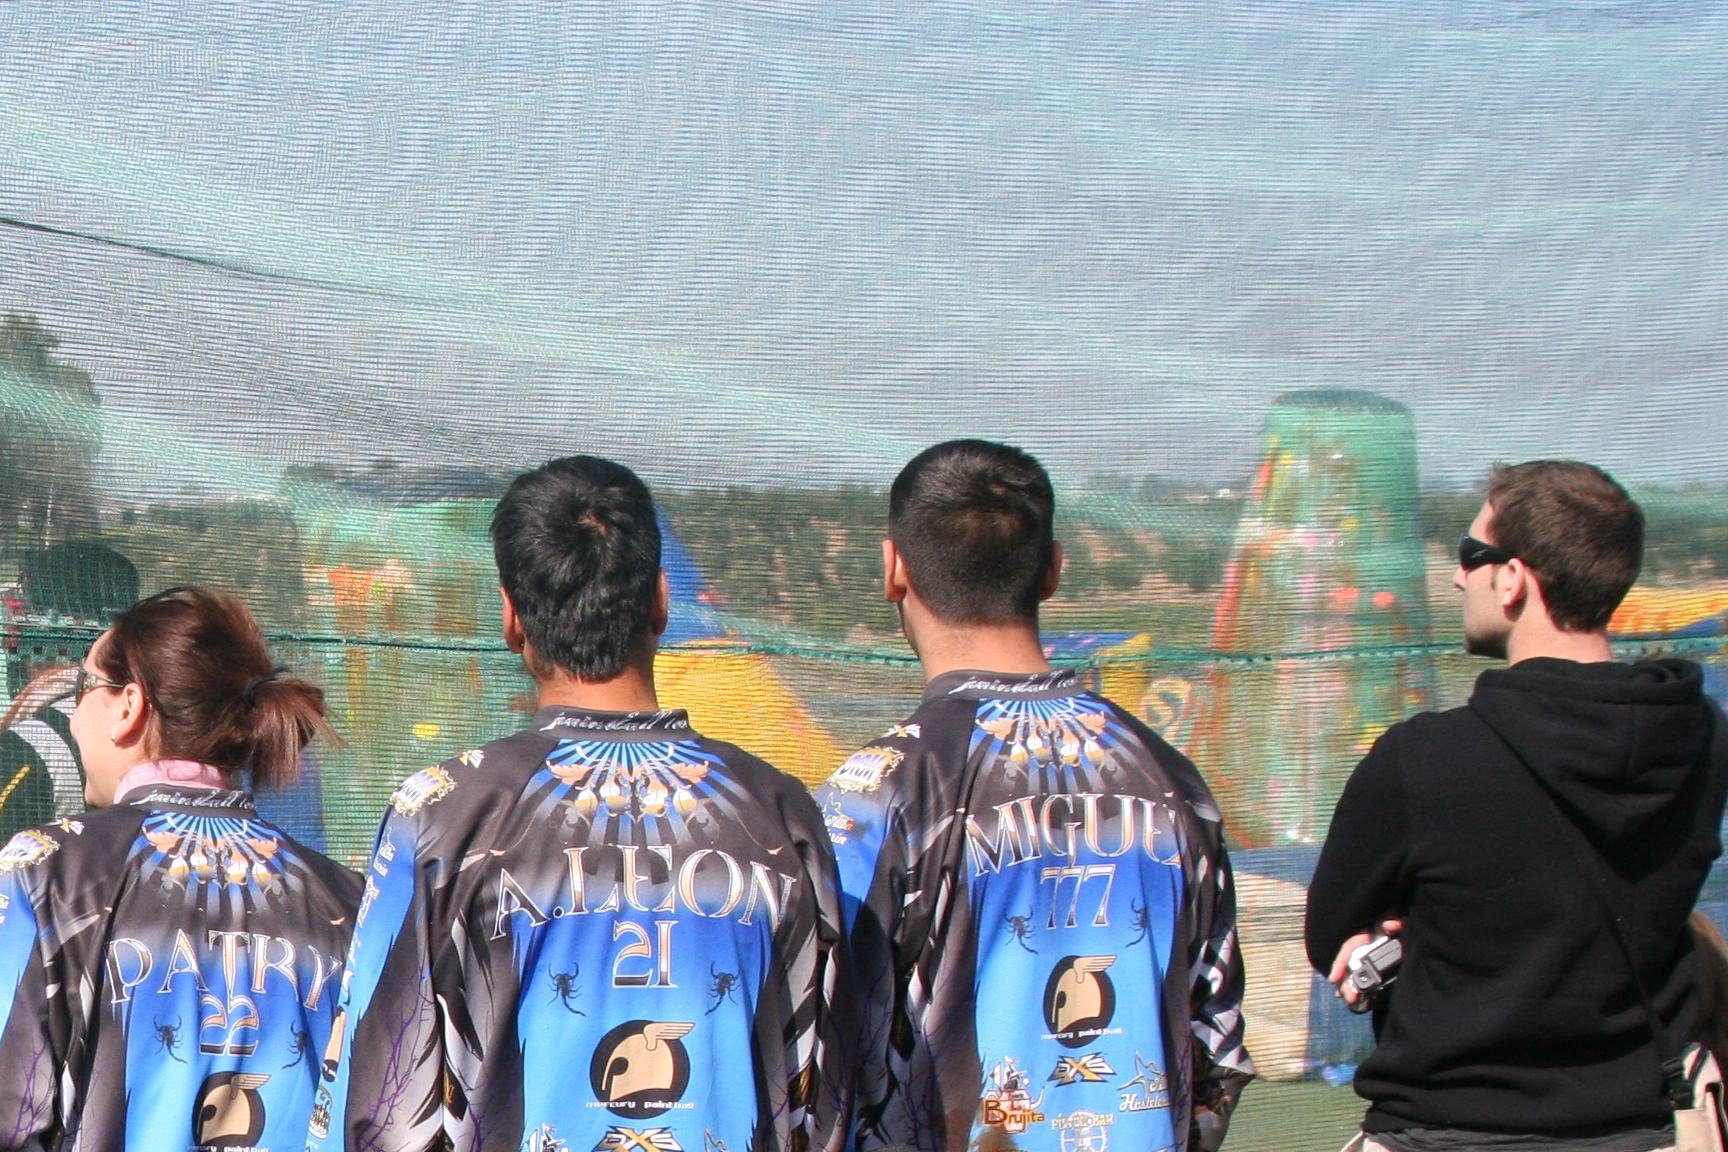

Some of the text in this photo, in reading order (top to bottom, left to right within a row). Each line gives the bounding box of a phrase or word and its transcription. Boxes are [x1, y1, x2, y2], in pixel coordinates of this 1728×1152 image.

[964, 792, 1182, 877] MIGUE
[490, 843, 798, 941] A.LEON
[1040, 863, 1117, 931] 777
[106, 928, 343, 1011] PATRY
[612, 919, 680, 989] 21
[199, 994, 261, 1057] 22
[585, 1100, 637, 1110] mercury
[983, 1099, 1046, 1128] Brujita
